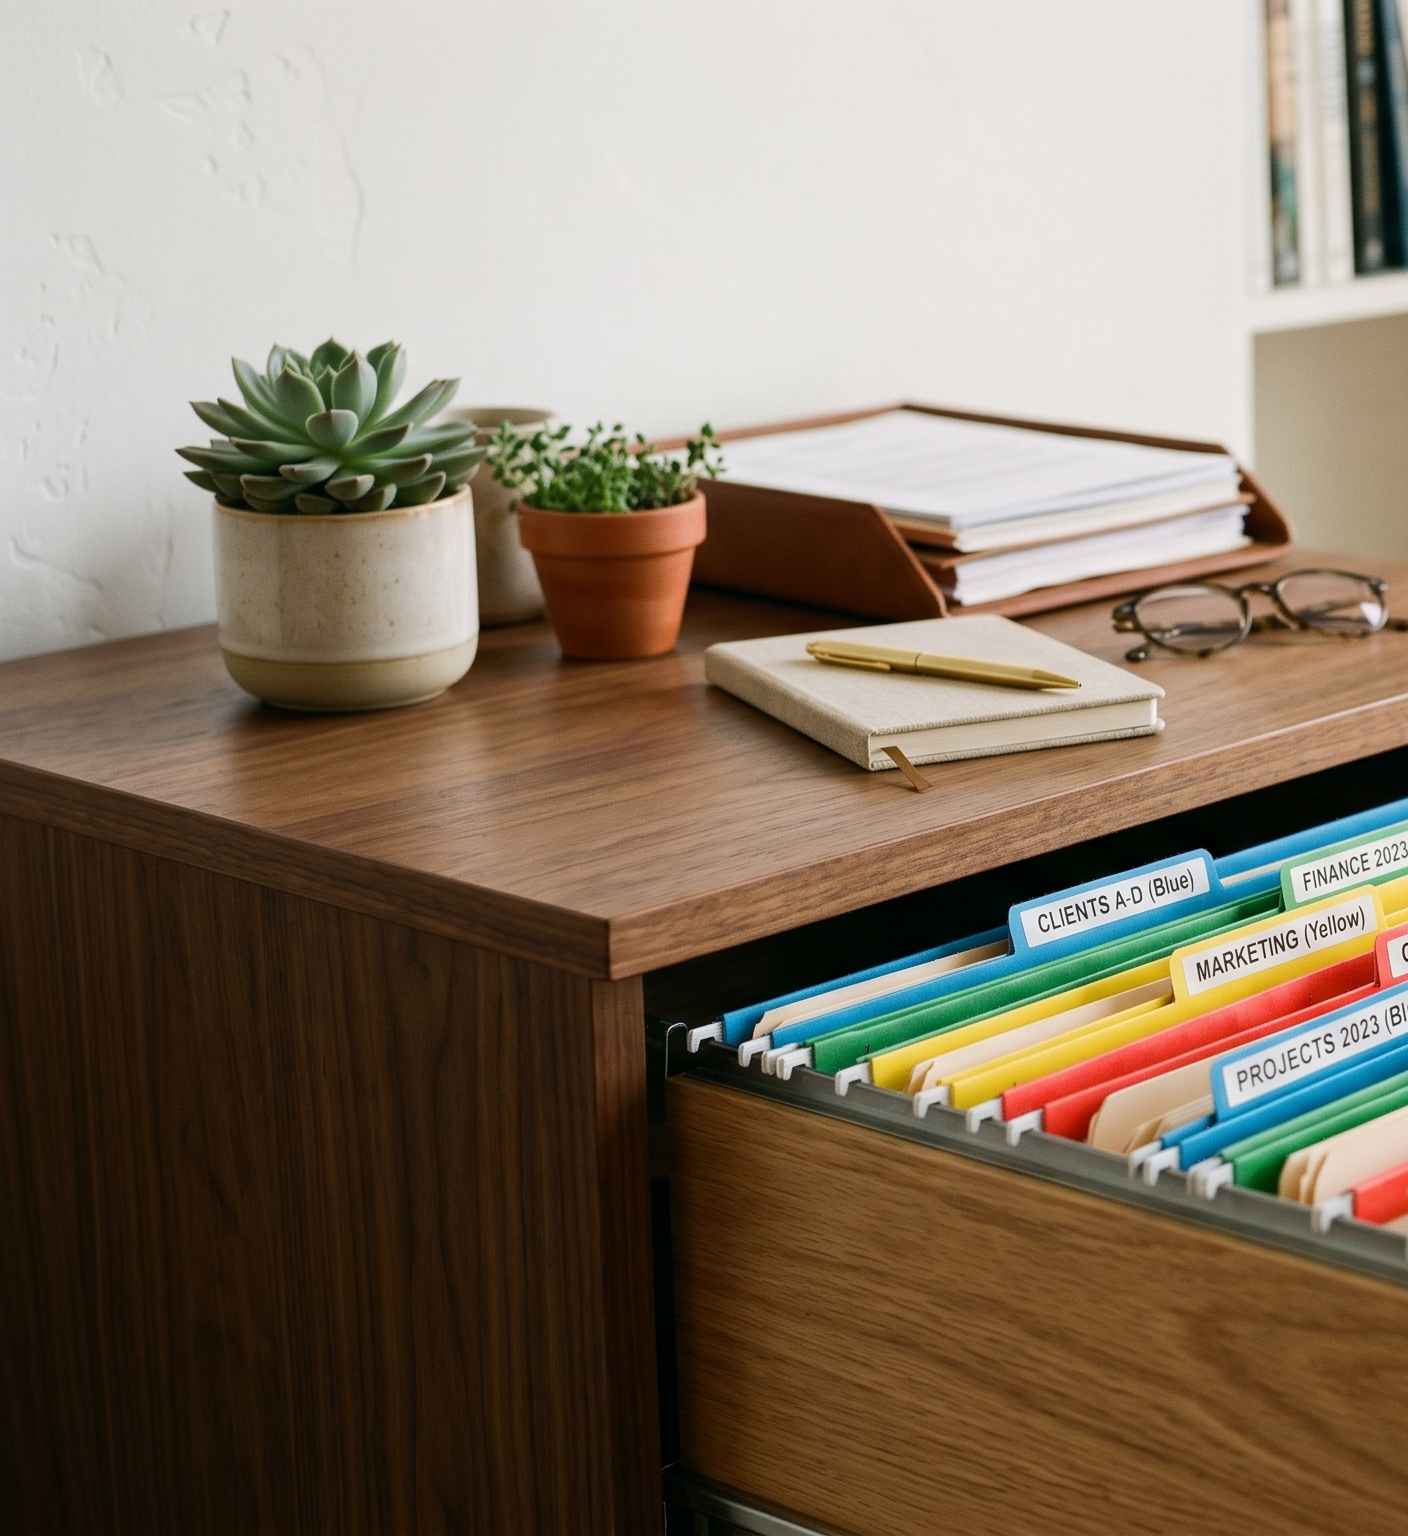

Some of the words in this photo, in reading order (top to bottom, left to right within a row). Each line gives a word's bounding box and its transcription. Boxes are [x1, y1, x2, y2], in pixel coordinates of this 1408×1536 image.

[1037, 895, 1110, 934] CLIENTS
[1115, 885, 1144, 911] A-D
[1148, 868, 1195, 904] (Blue)
[1302, 852, 1371, 892] FINANCE
[1195, 929, 1300, 982] MARKETING
[1304, 905, 1366, 949] (Yellow)
[1236, 1032, 1336, 1092] PROJECTS
[1340, 1014, 1380, 1048] 2023
